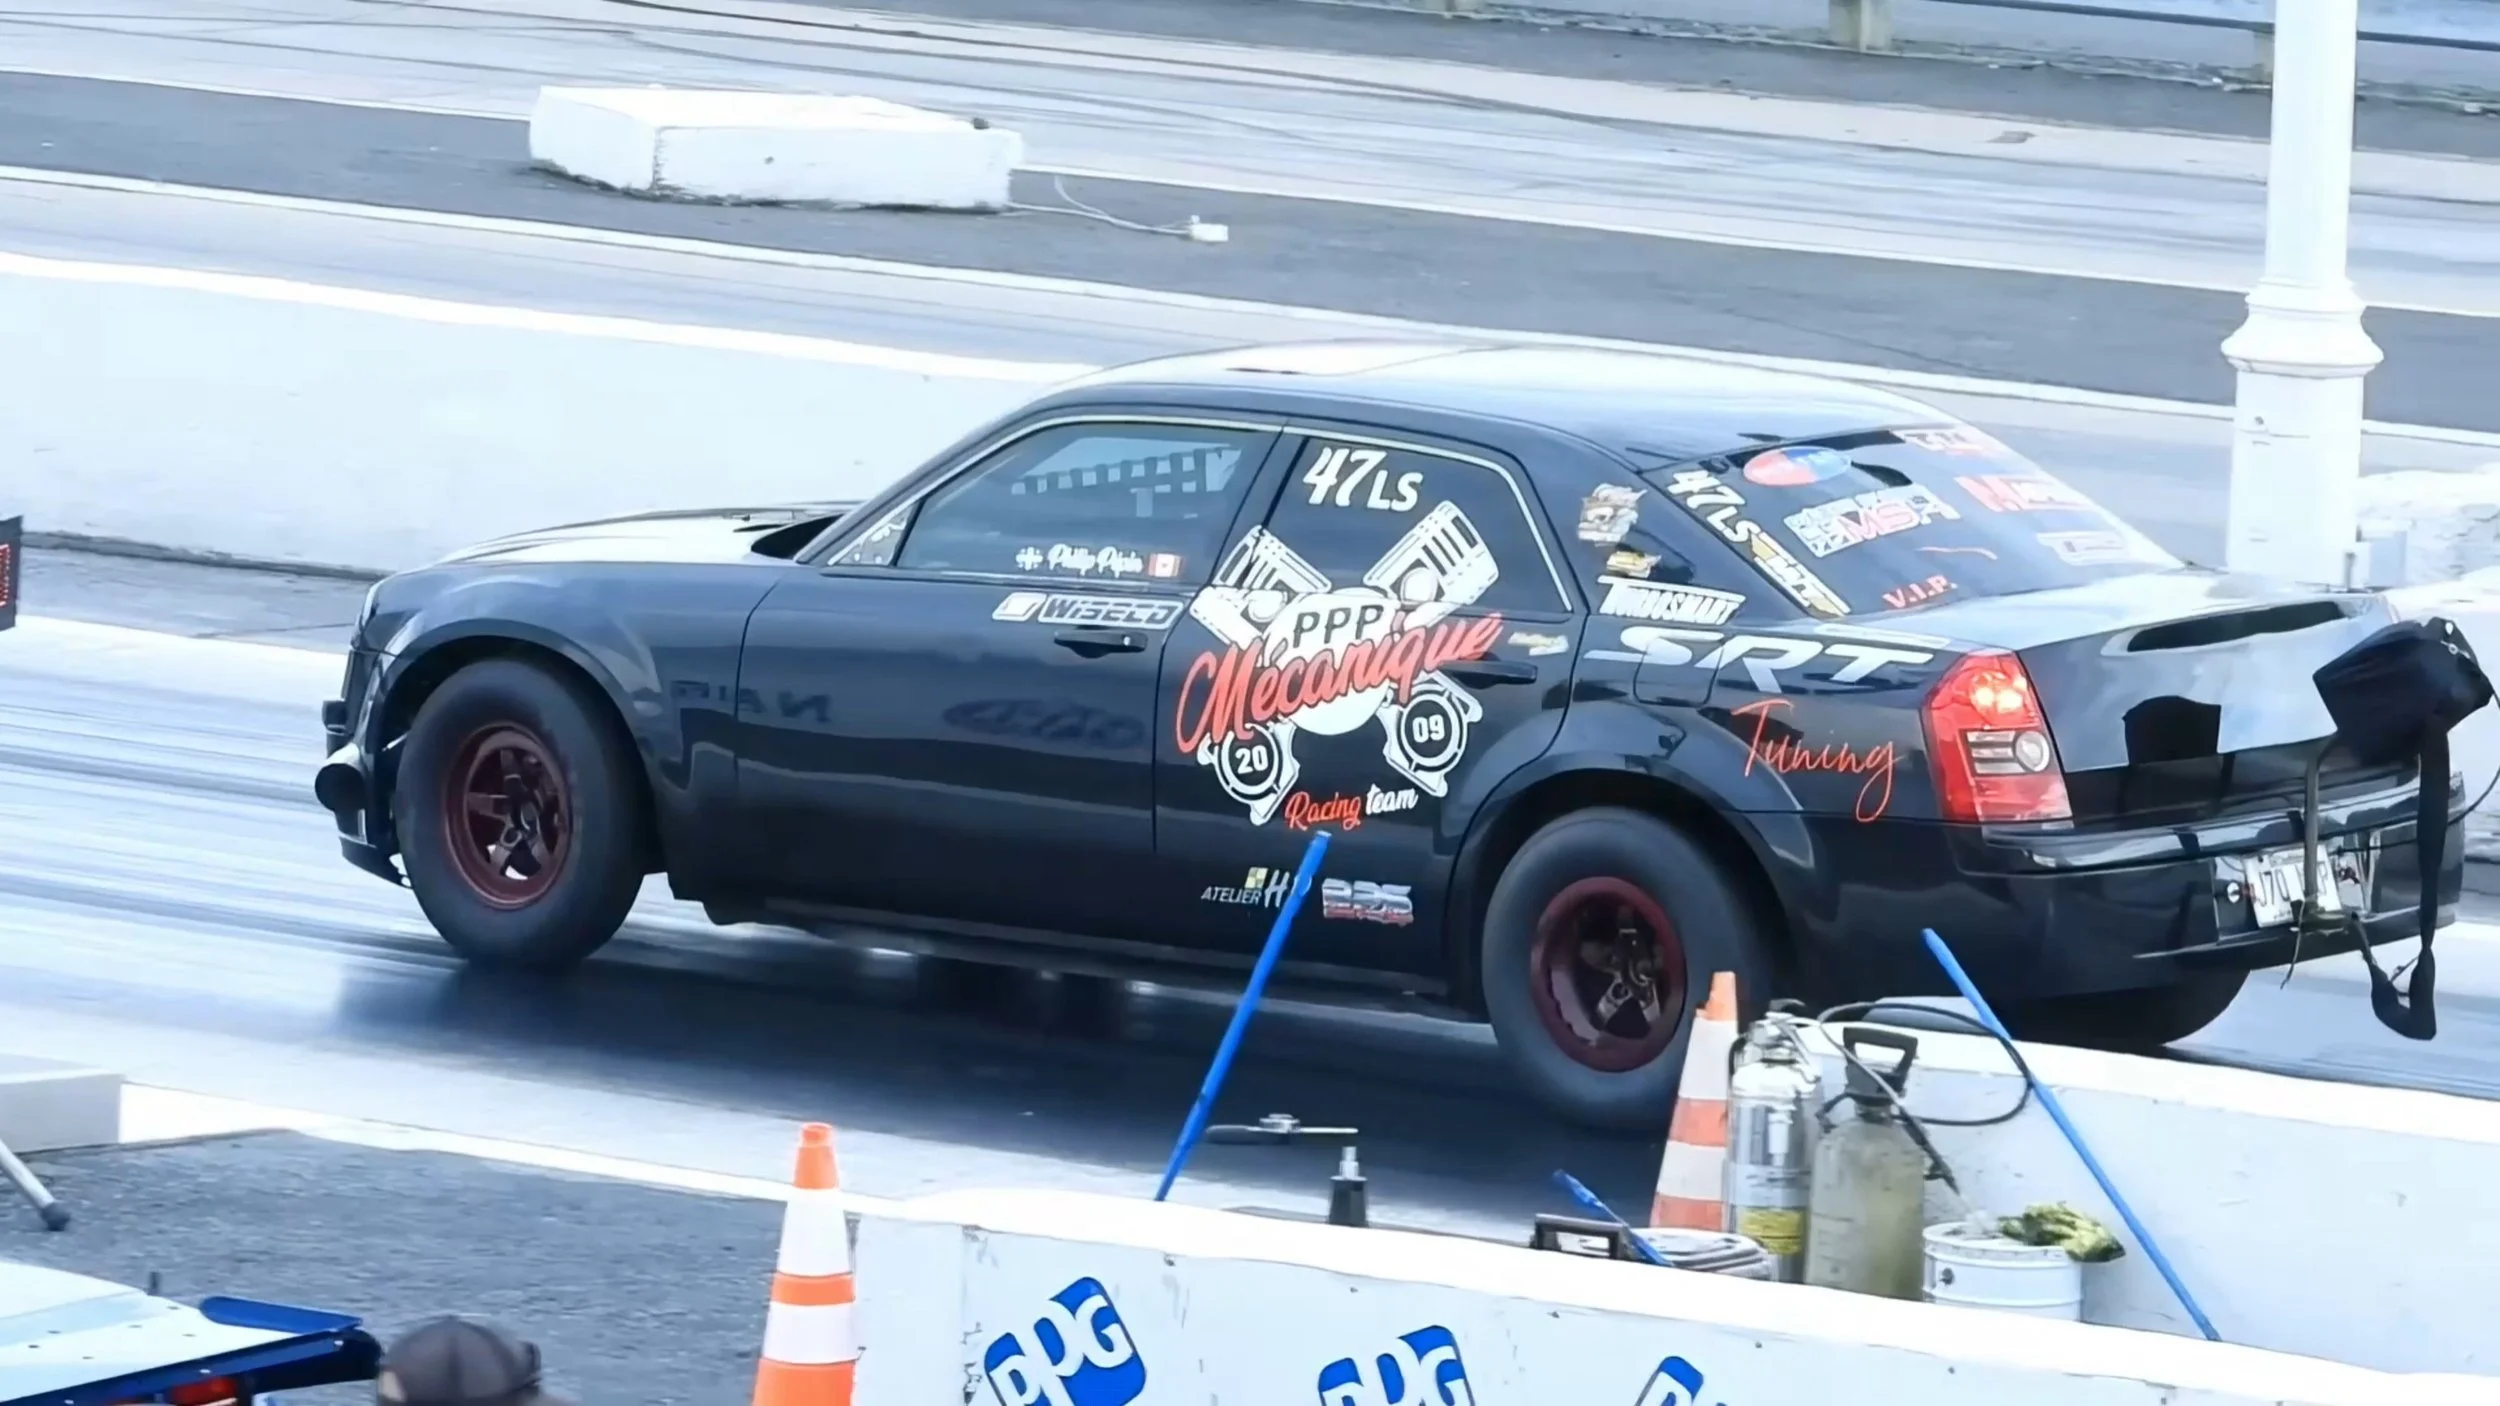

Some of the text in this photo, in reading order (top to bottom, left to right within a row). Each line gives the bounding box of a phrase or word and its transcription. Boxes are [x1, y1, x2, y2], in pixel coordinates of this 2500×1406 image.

[1292, 604, 1384, 648] PPP
[1176, 610, 1503, 752] Mécanique
[1584, 626, 1934, 694] SRT
[1412, 714, 1446, 744] 09
[1235, 747, 1269, 775] 20
[1731, 697, 1900, 823] Tuning
[1284, 783, 1419, 830] Racing team
[1200, 886, 1263, 906] ATELIER
